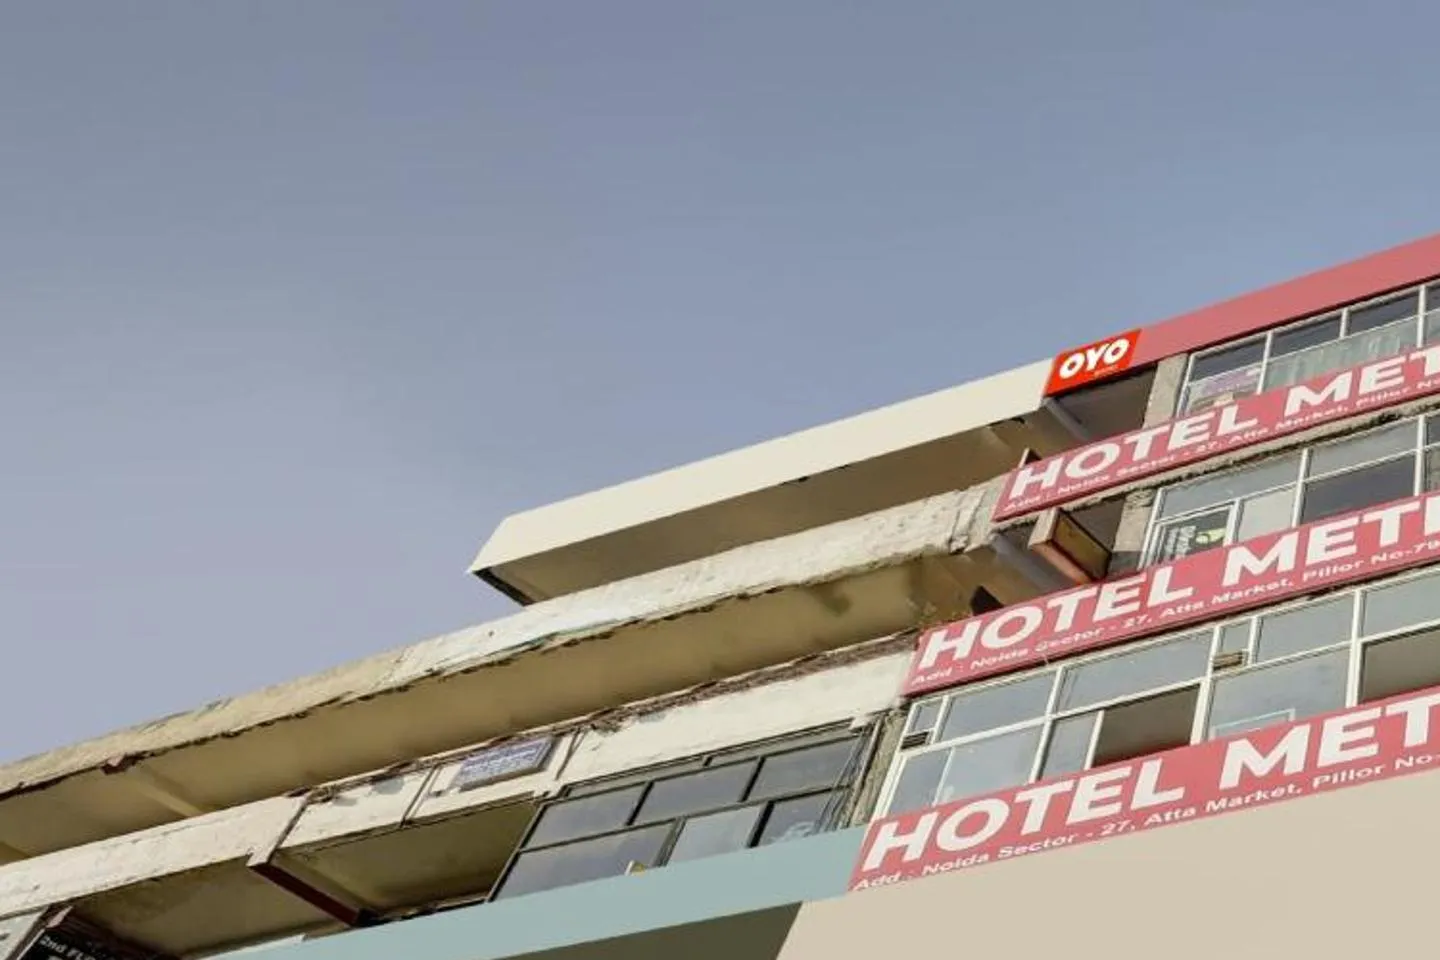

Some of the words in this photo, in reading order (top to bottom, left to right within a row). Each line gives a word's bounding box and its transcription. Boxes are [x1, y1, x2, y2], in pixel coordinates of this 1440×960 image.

[1059, 338, 1130, 379] OYO
[1009, 406, 1258, 498] HOTEL
[918, 566, 1192, 670] HOTEL
[970, 647, 1028, 671] Noida
[1036, 627, 1103, 653] Sector
[1160, 600, 1204, 619] Atta
[862, 759, 1184, 872] HOTEL
[921, 852, 990, 877] Noida
[997, 832, 1076, 859] Sector
[1144, 805, 1196, 828] Atta
[1205, 782, 1302, 814] Market,
